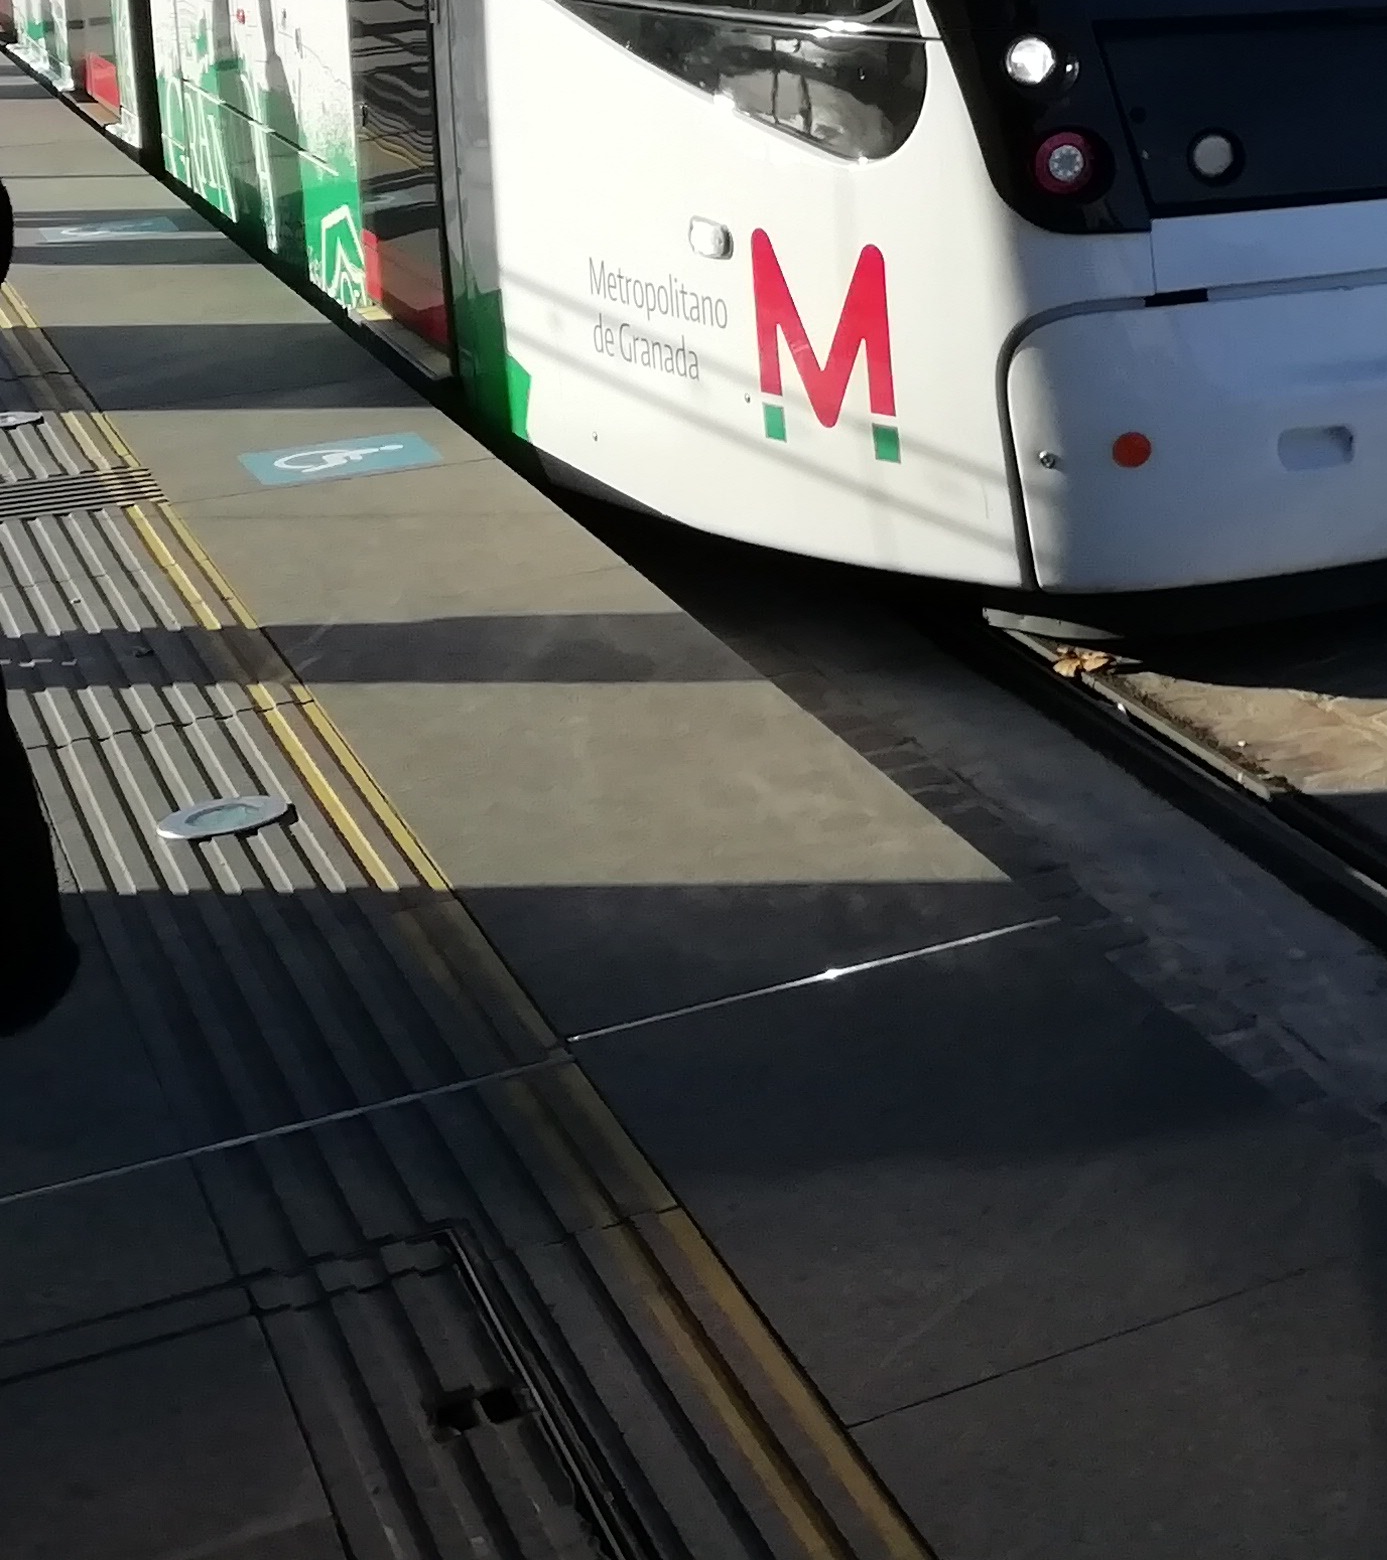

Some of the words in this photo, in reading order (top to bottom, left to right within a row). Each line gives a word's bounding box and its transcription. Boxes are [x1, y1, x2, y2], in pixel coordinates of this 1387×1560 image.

[588, 255, 729, 330] Metropolitano
[592, 313, 616, 357] de
[618, 322, 700, 382] Granada
[750, 227, 900, 450] M
